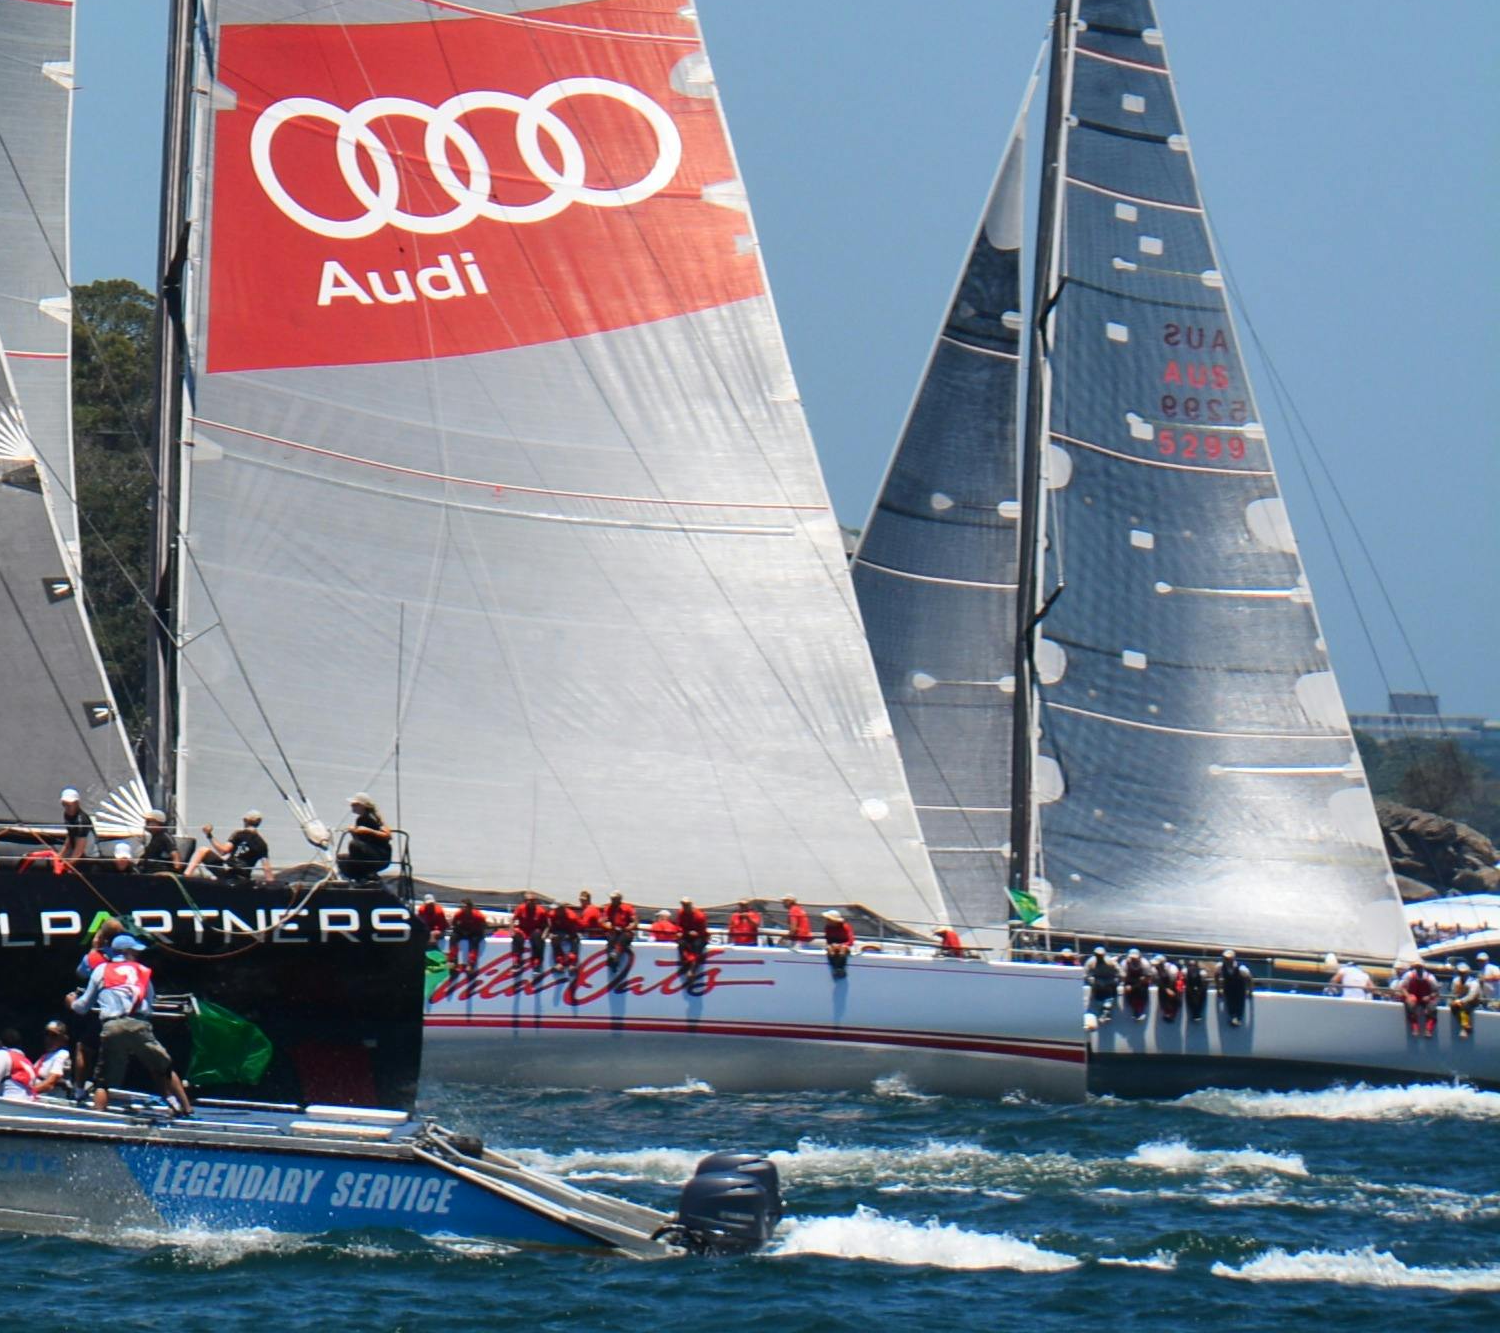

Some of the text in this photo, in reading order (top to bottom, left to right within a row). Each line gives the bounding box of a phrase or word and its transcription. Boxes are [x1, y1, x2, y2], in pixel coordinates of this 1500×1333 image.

[315, 249, 490, 307] Audi
[1163, 360, 1230, 390] AUS
[1158, 428, 1246, 460] 5299
[152, 1157, 459, 1215] LEGENDARY SERVICE
